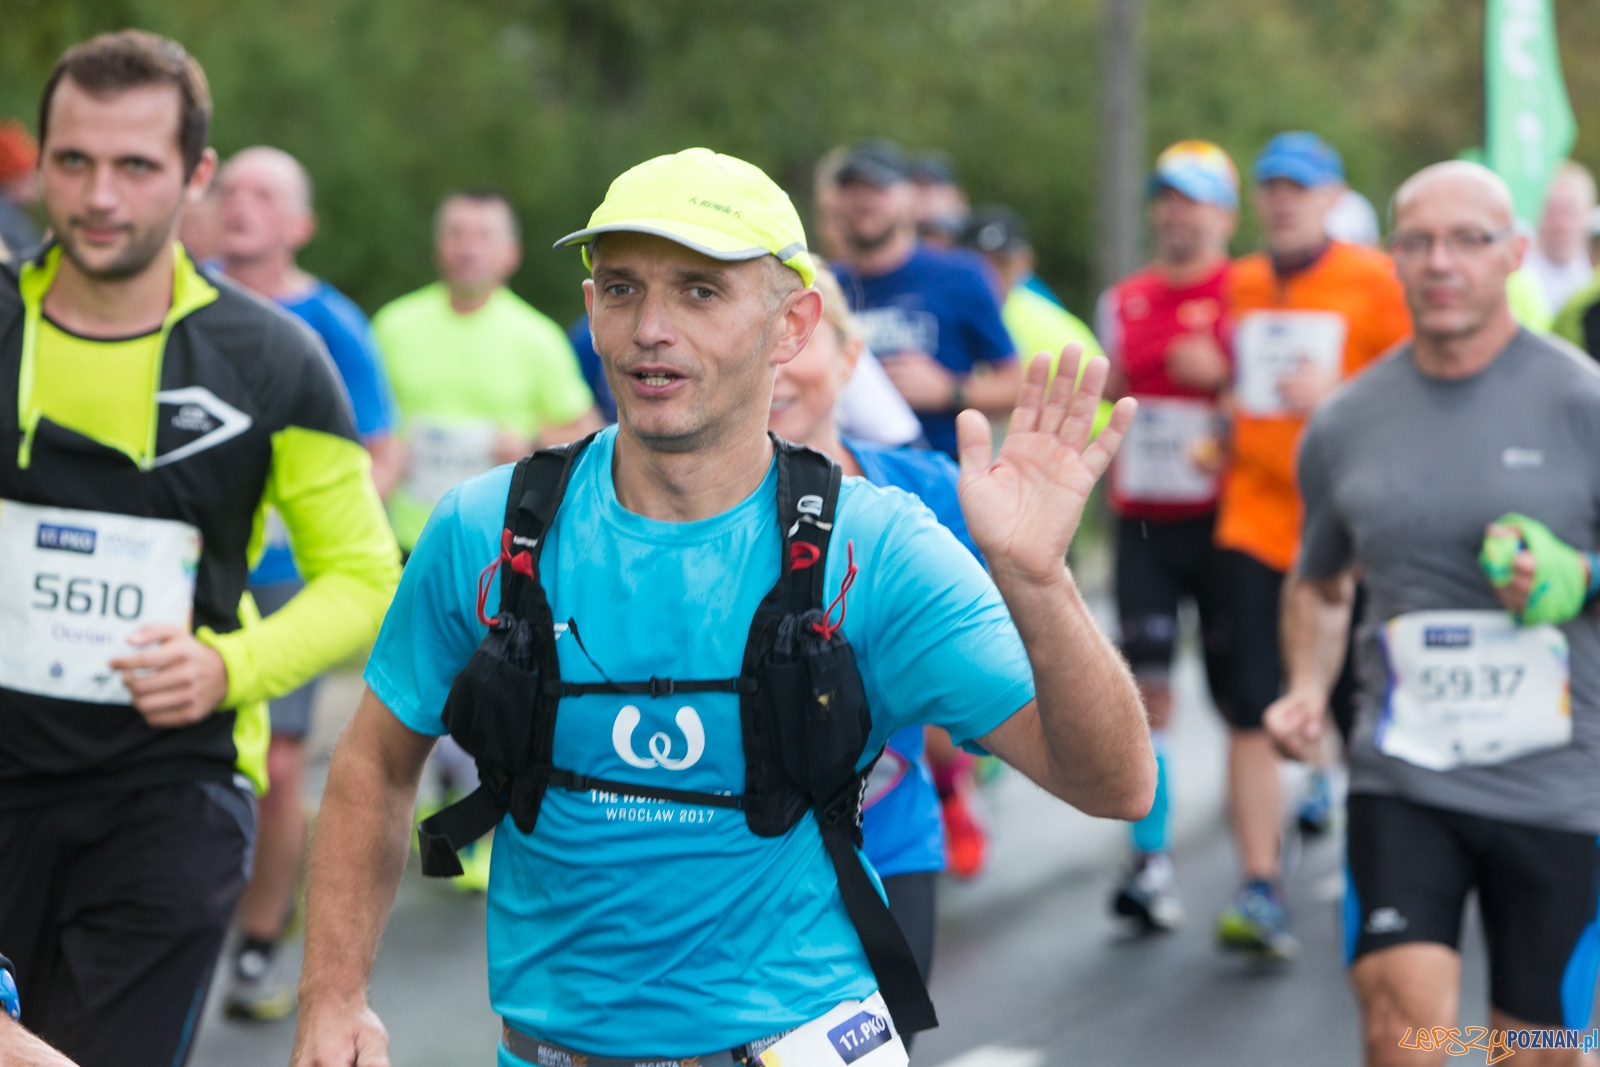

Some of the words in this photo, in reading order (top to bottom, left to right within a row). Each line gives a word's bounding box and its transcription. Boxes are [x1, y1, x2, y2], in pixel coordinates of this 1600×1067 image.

[32, 573, 143, 620] 5610
[1419, 663, 1525, 703] 5937
[590, 788, 619, 804] THE
[679, 809, 715, 824] 2017
[838, 1014, 886, 1052] 17.PKO
